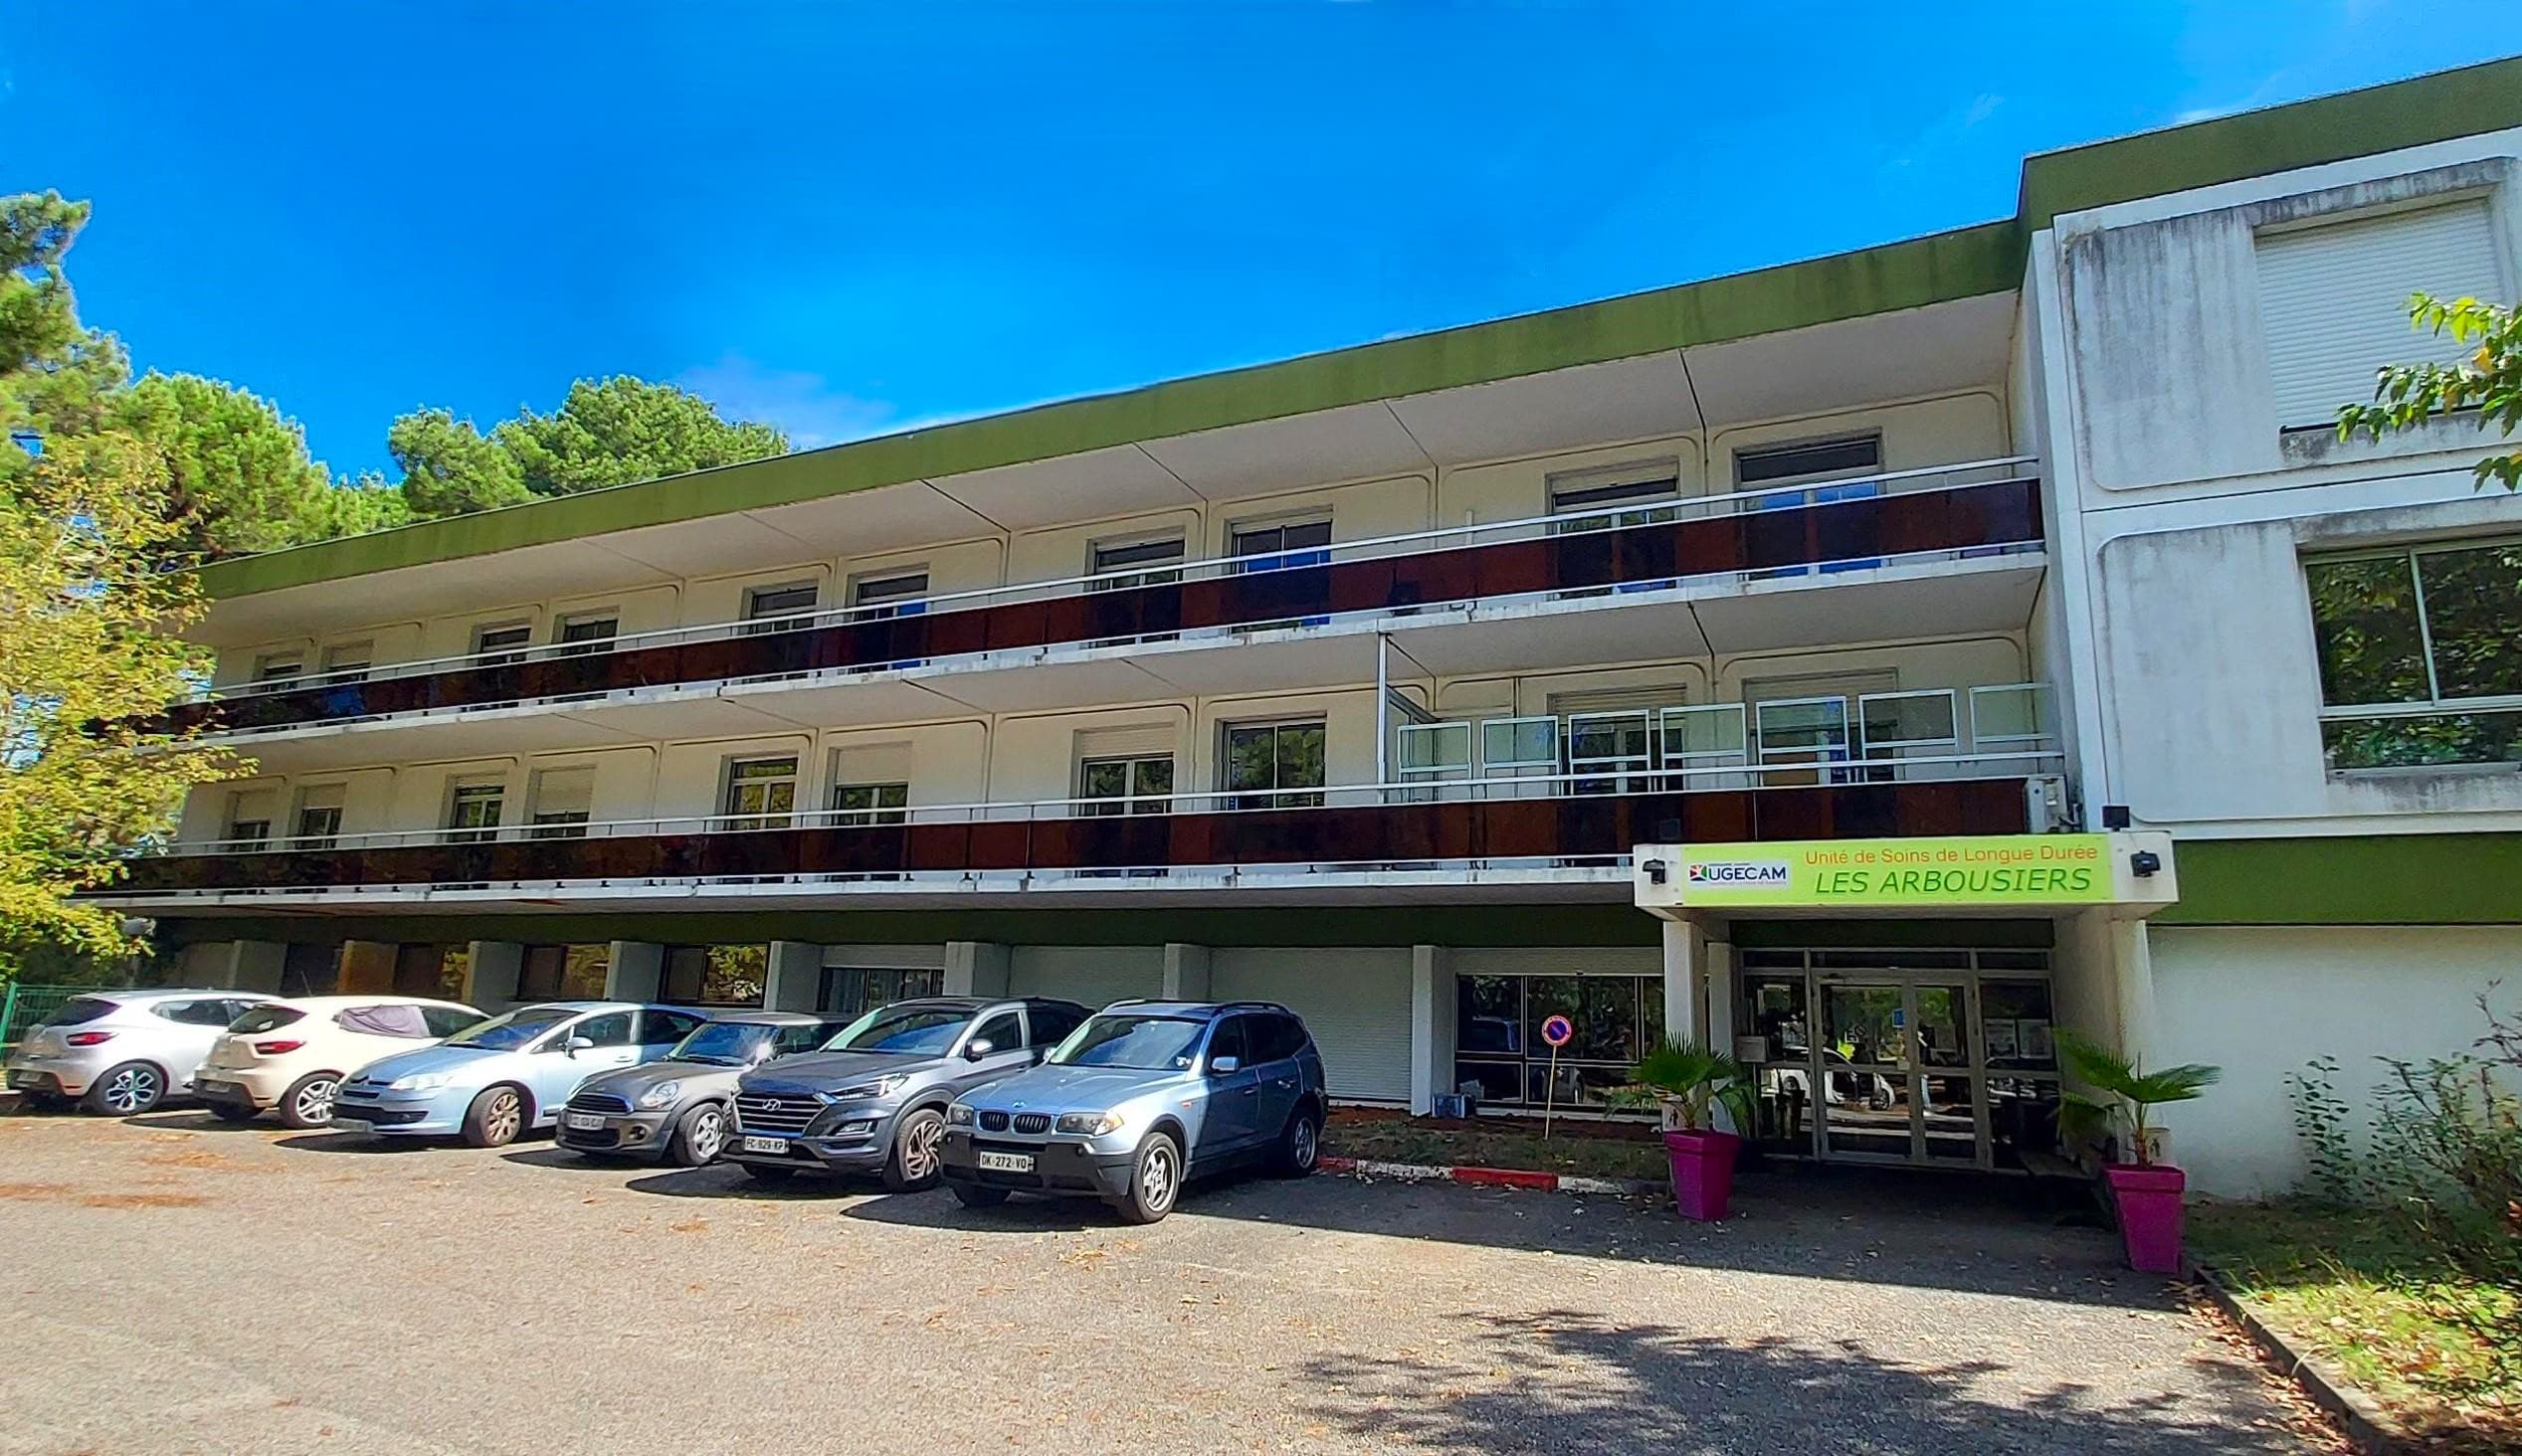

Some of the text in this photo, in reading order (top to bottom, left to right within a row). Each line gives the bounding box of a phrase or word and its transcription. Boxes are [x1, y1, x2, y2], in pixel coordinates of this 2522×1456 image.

[1806, 844, 2097, 864] Unité de Soins de Longue Durée
[1708, 866, 1786, 881] UGECAM
[1815, 867, 2092, 894] LES ARBOUSIERS
